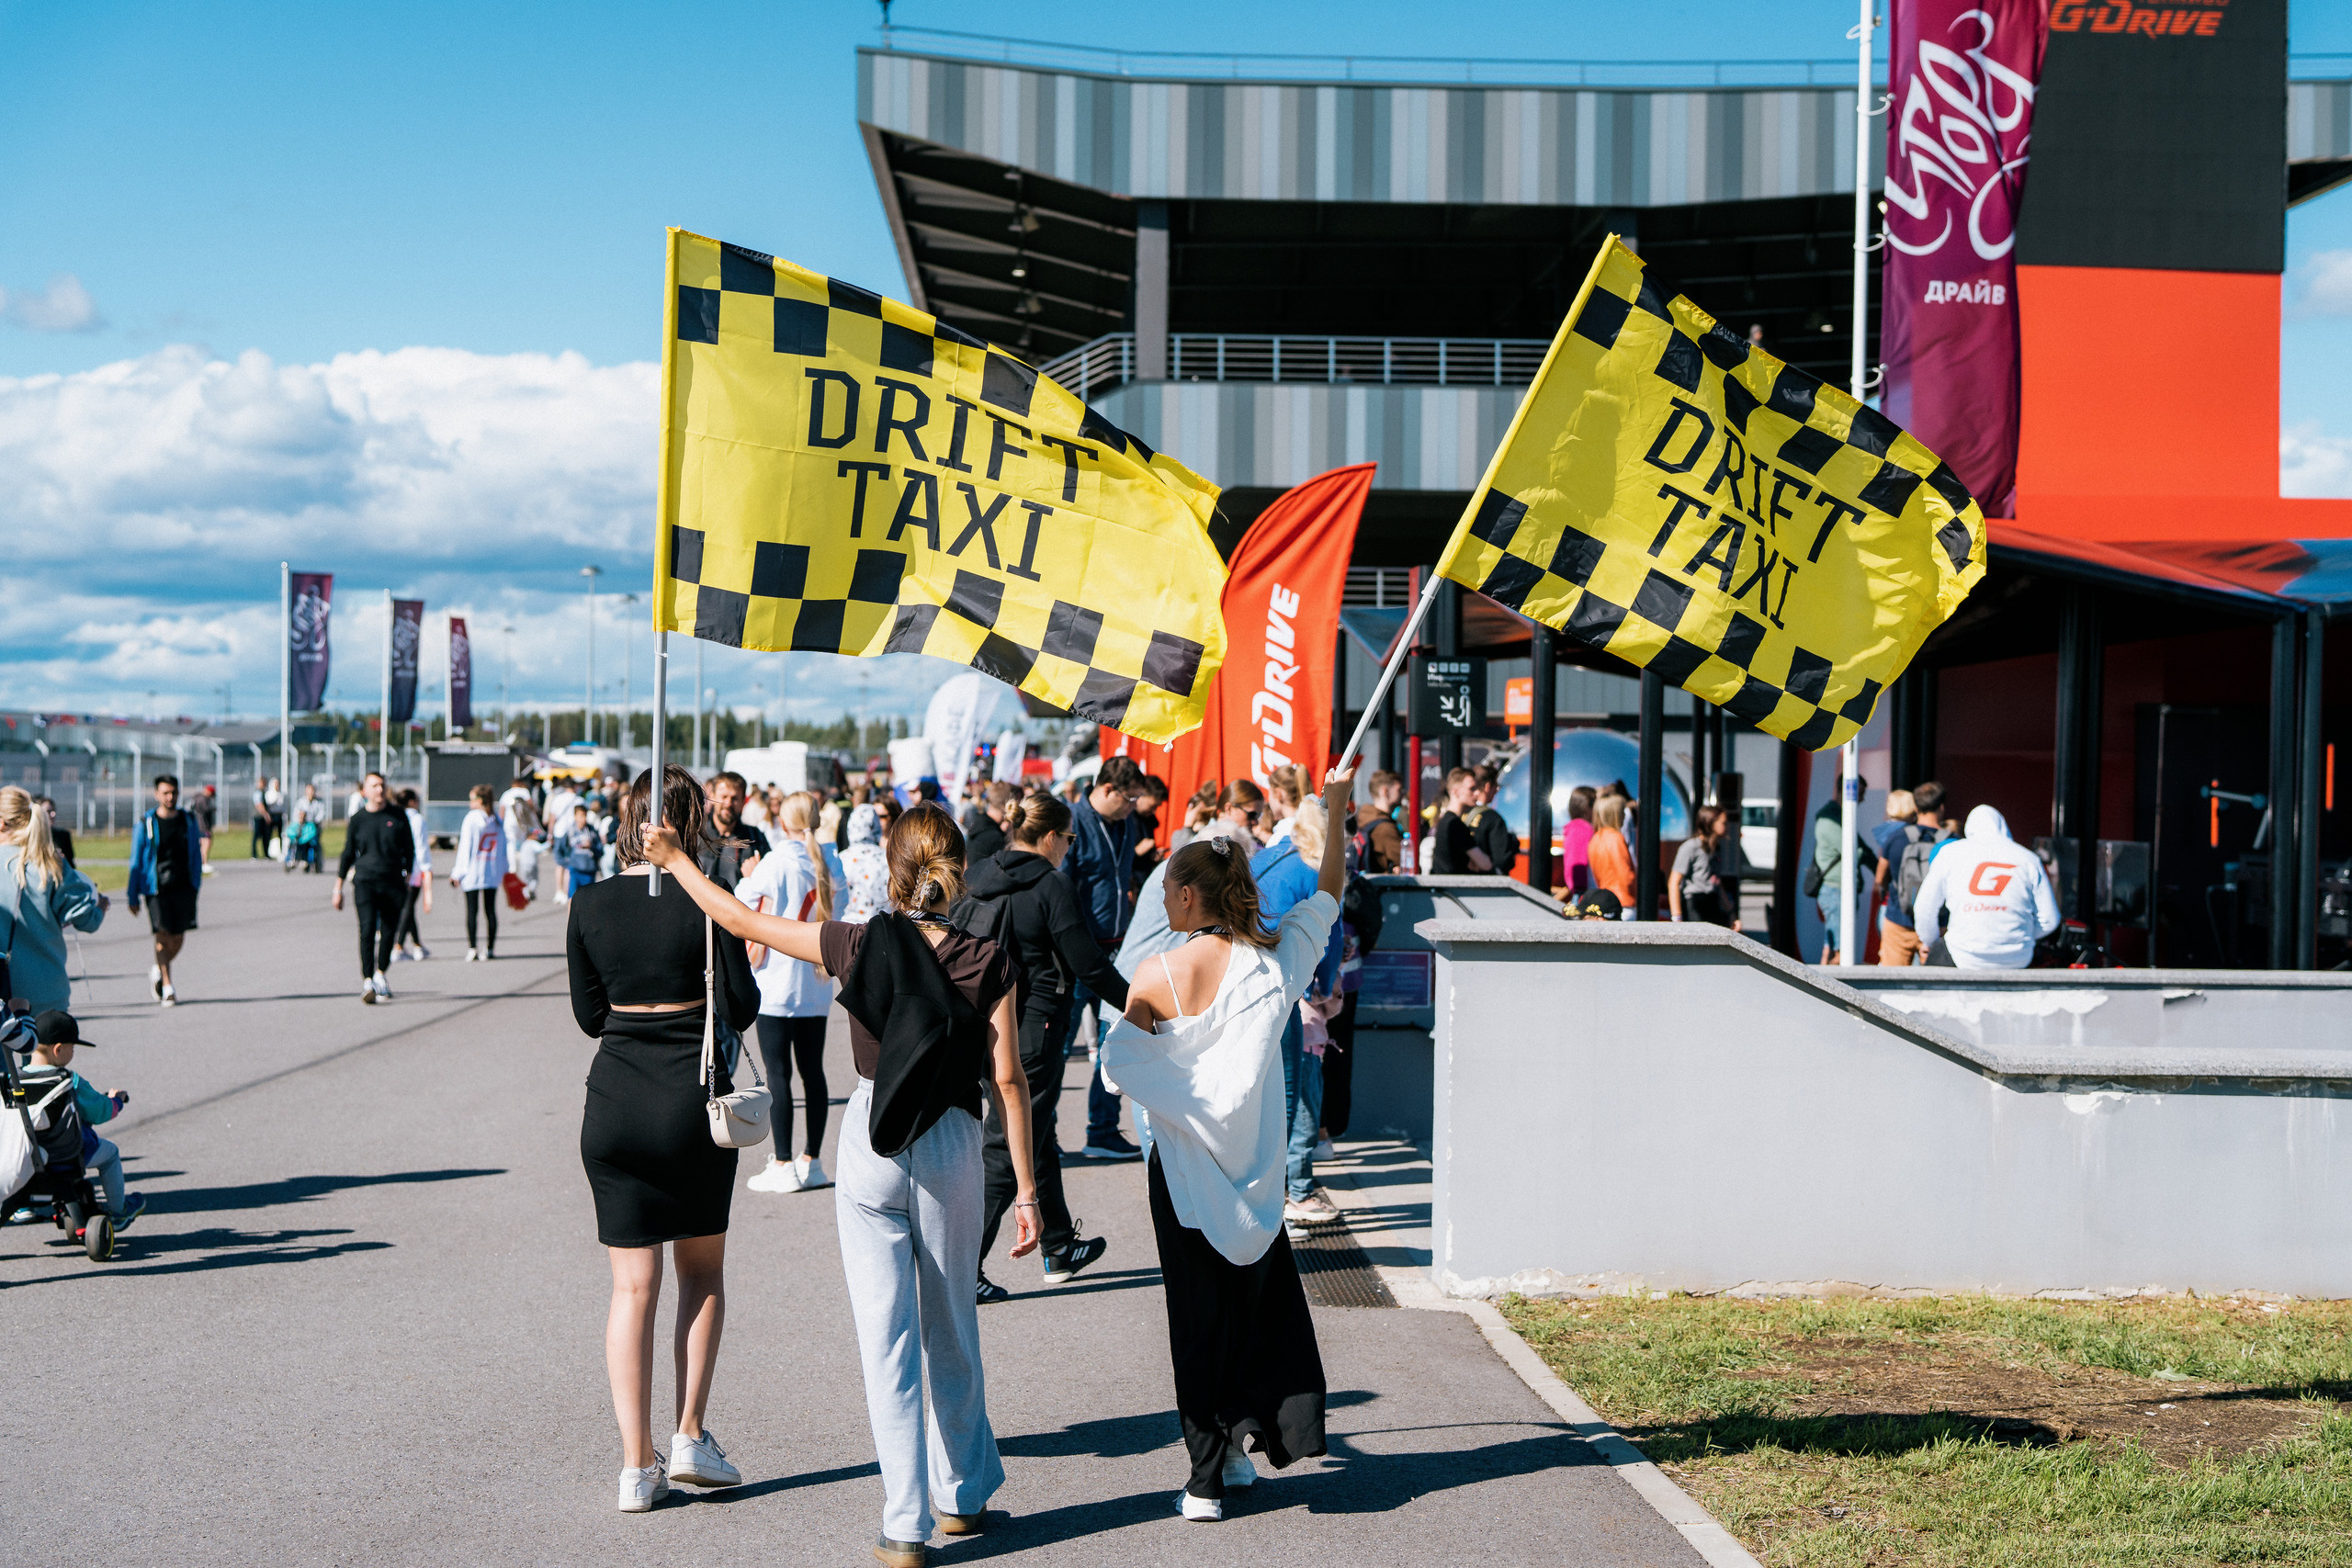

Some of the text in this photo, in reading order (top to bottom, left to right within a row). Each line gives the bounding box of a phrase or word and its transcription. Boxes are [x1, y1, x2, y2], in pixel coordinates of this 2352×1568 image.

[1923, 279, 2007, 306] ДРАЙВ
[805, 367, 1099, 503] DRIFT
[1643, 396, 1868, 564] DRIFT
[838, 460, 1054, 582] TAXI
[1646, 484, 1800, 631] TAXI
